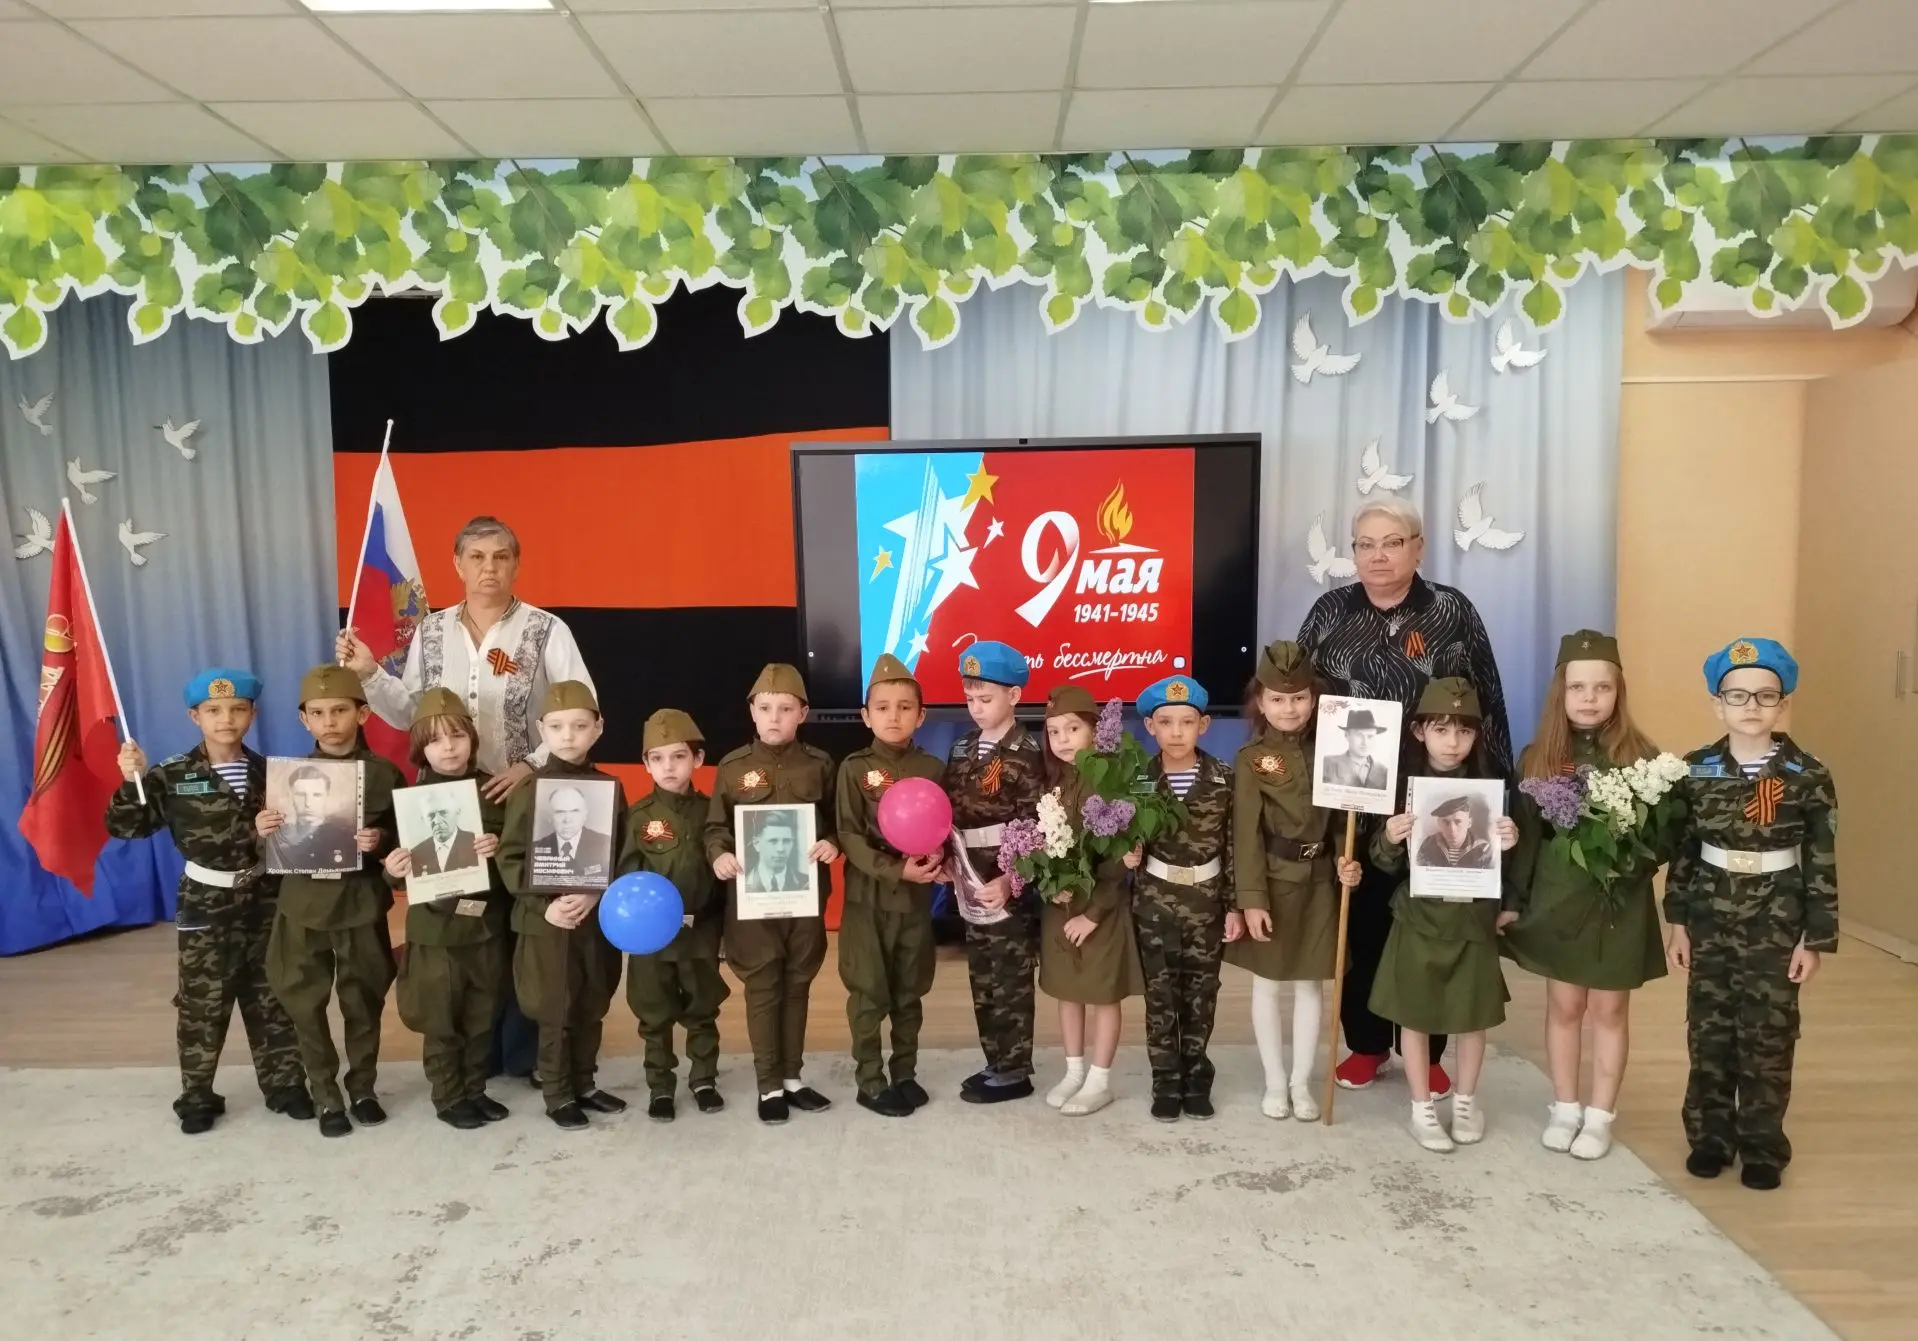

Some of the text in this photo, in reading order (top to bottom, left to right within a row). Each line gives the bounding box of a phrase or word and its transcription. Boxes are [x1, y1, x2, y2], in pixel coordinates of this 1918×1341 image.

[1014, 511, 1164, 628] 9 мая
[1074, 603, 1160, 623] 1941-1945
[1053, 643, 1168, 681] бессмертна
